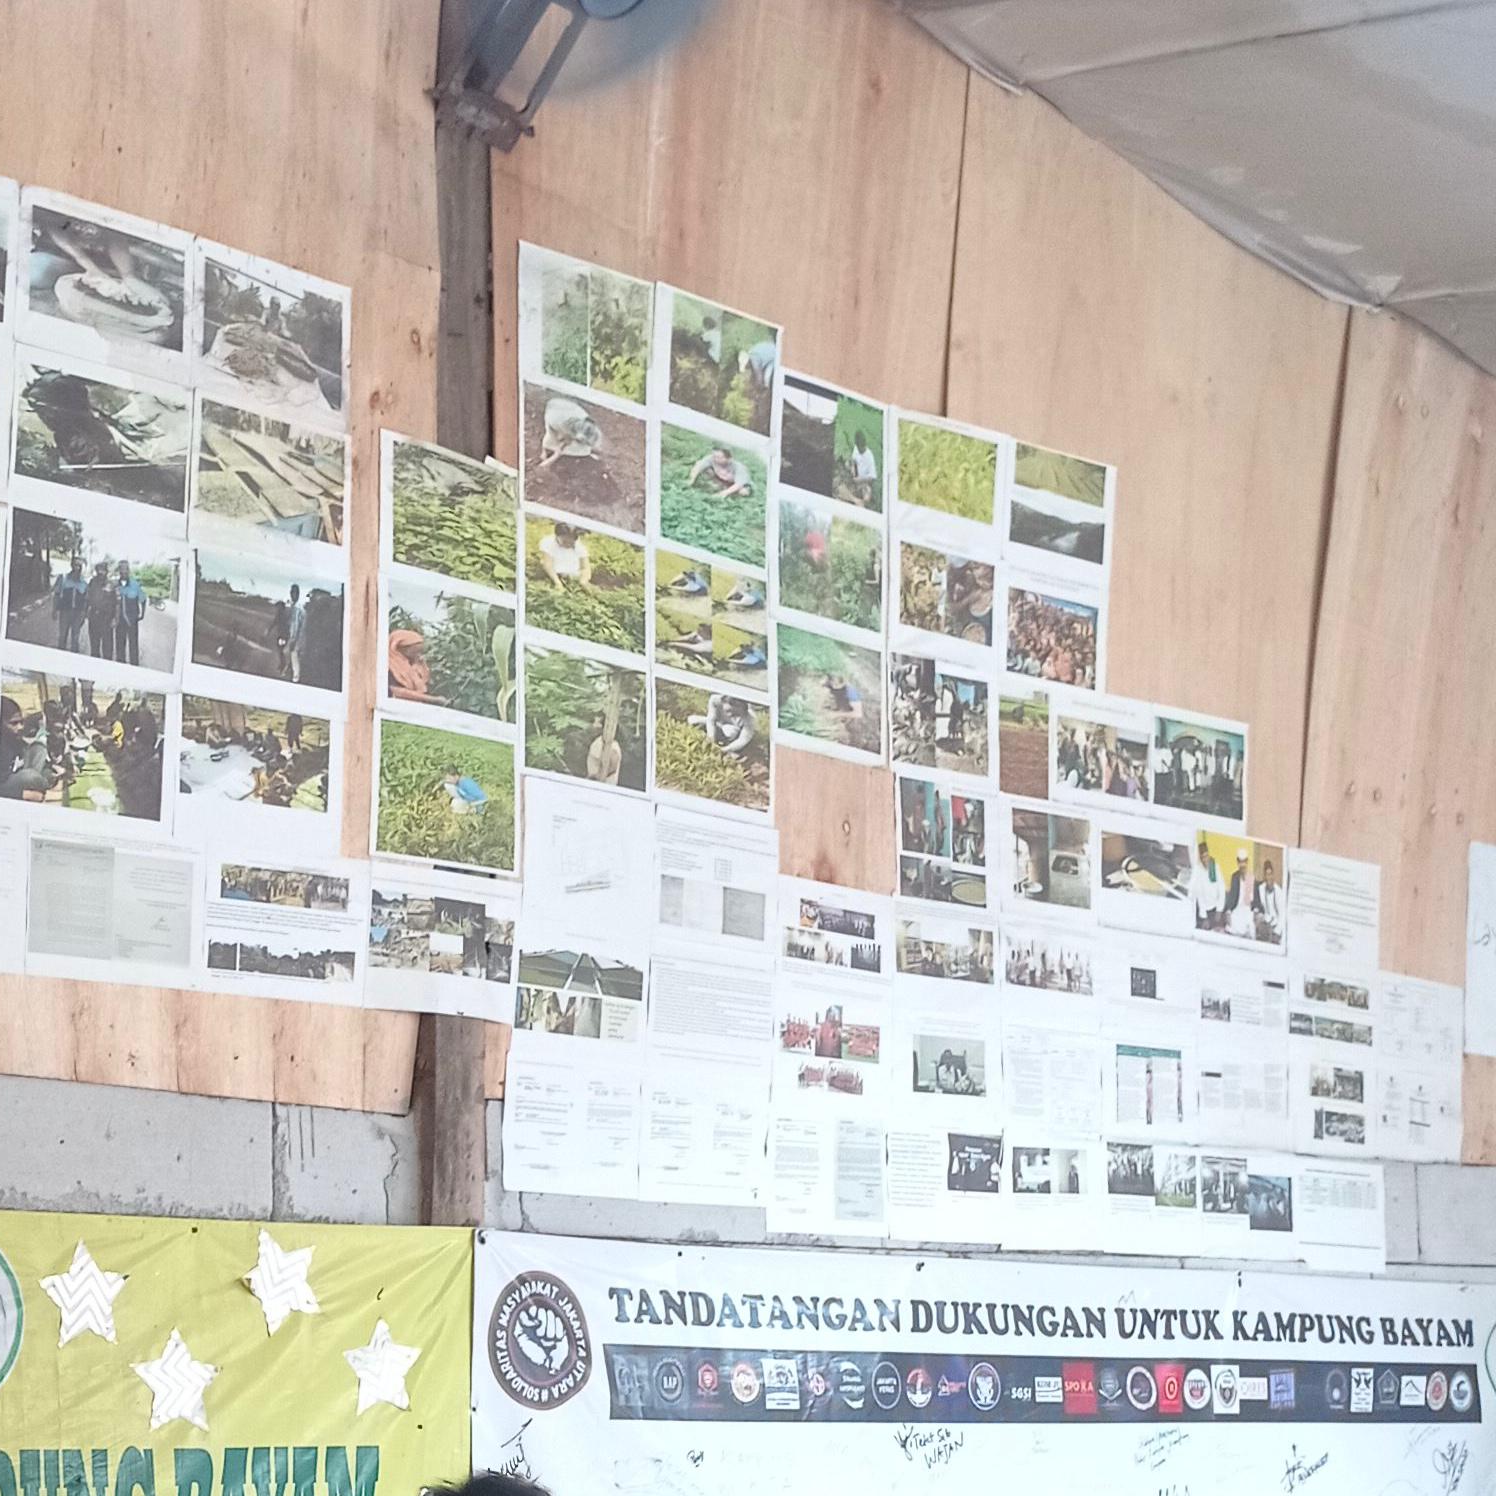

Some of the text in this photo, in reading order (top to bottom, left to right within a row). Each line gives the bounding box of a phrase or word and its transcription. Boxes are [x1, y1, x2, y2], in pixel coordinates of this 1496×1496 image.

[608, 1286, 1475, 1348] TANDATANGAN DUKUNGAN UNTUK KAMPUNG BAYAM
